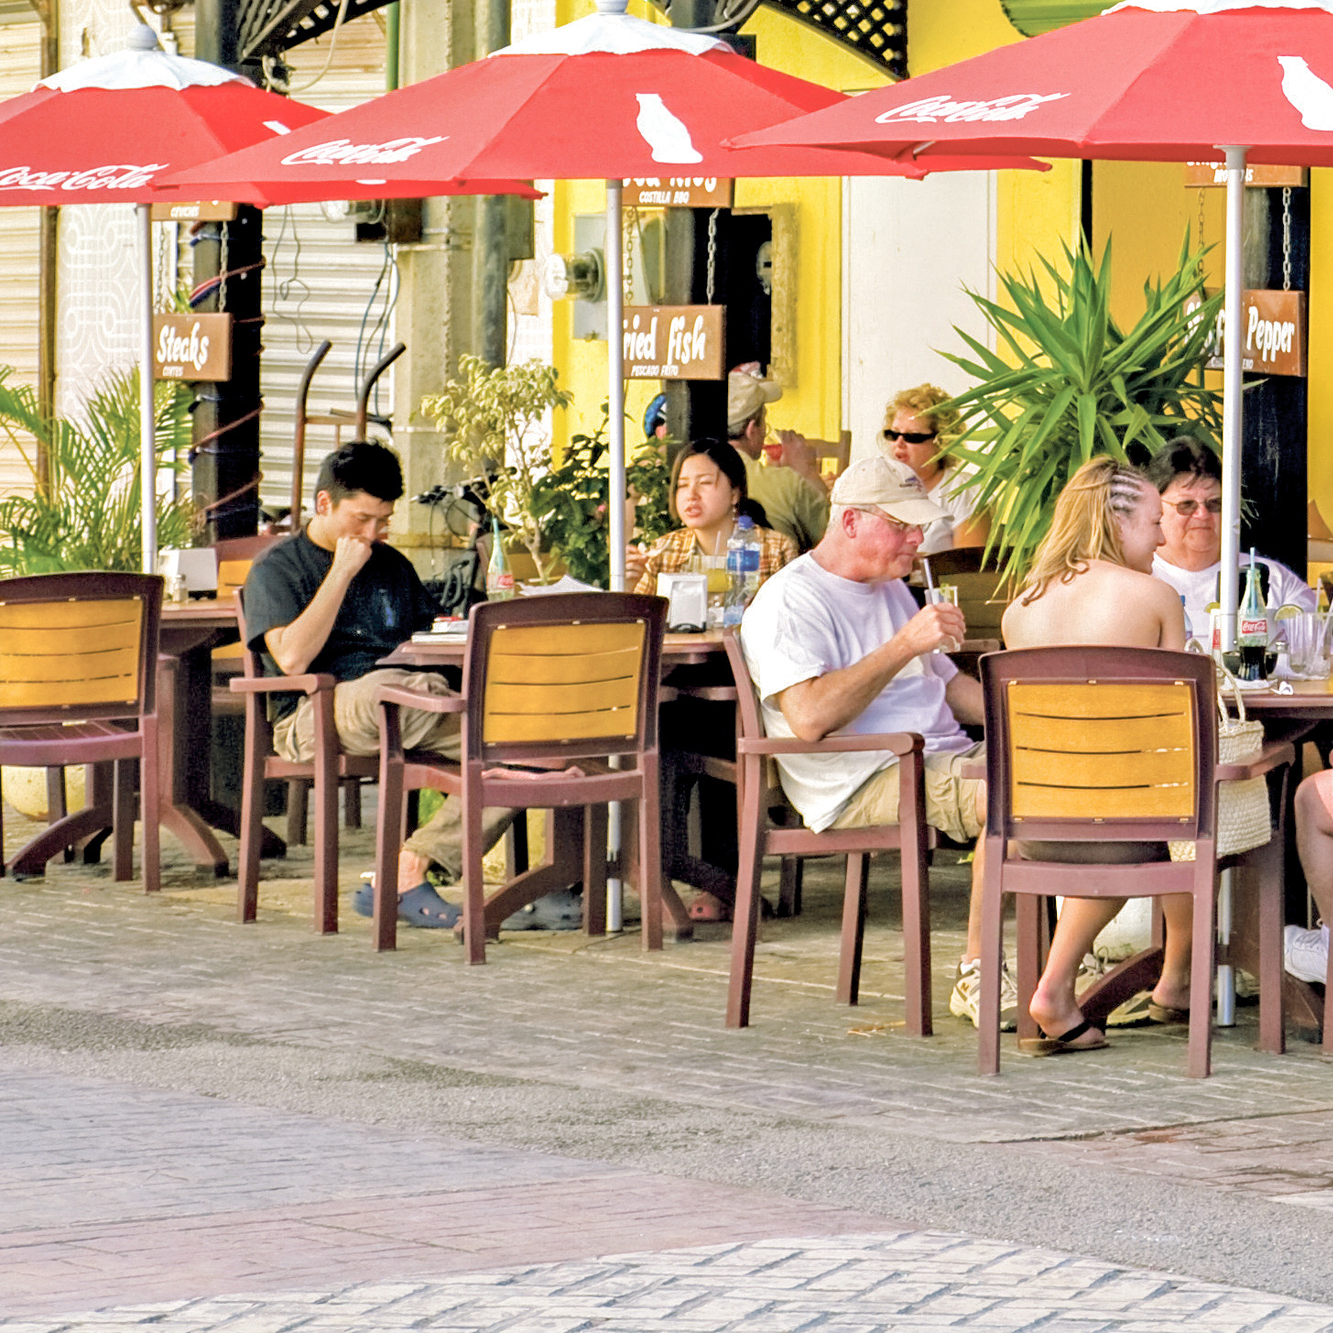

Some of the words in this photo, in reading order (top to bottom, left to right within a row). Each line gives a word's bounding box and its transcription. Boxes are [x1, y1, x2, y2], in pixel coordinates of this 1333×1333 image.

[156, 321, 210, 371] Steaks
[623, 314, 658, 361] ried
[1246, 305, 1295, 363] Pepper
